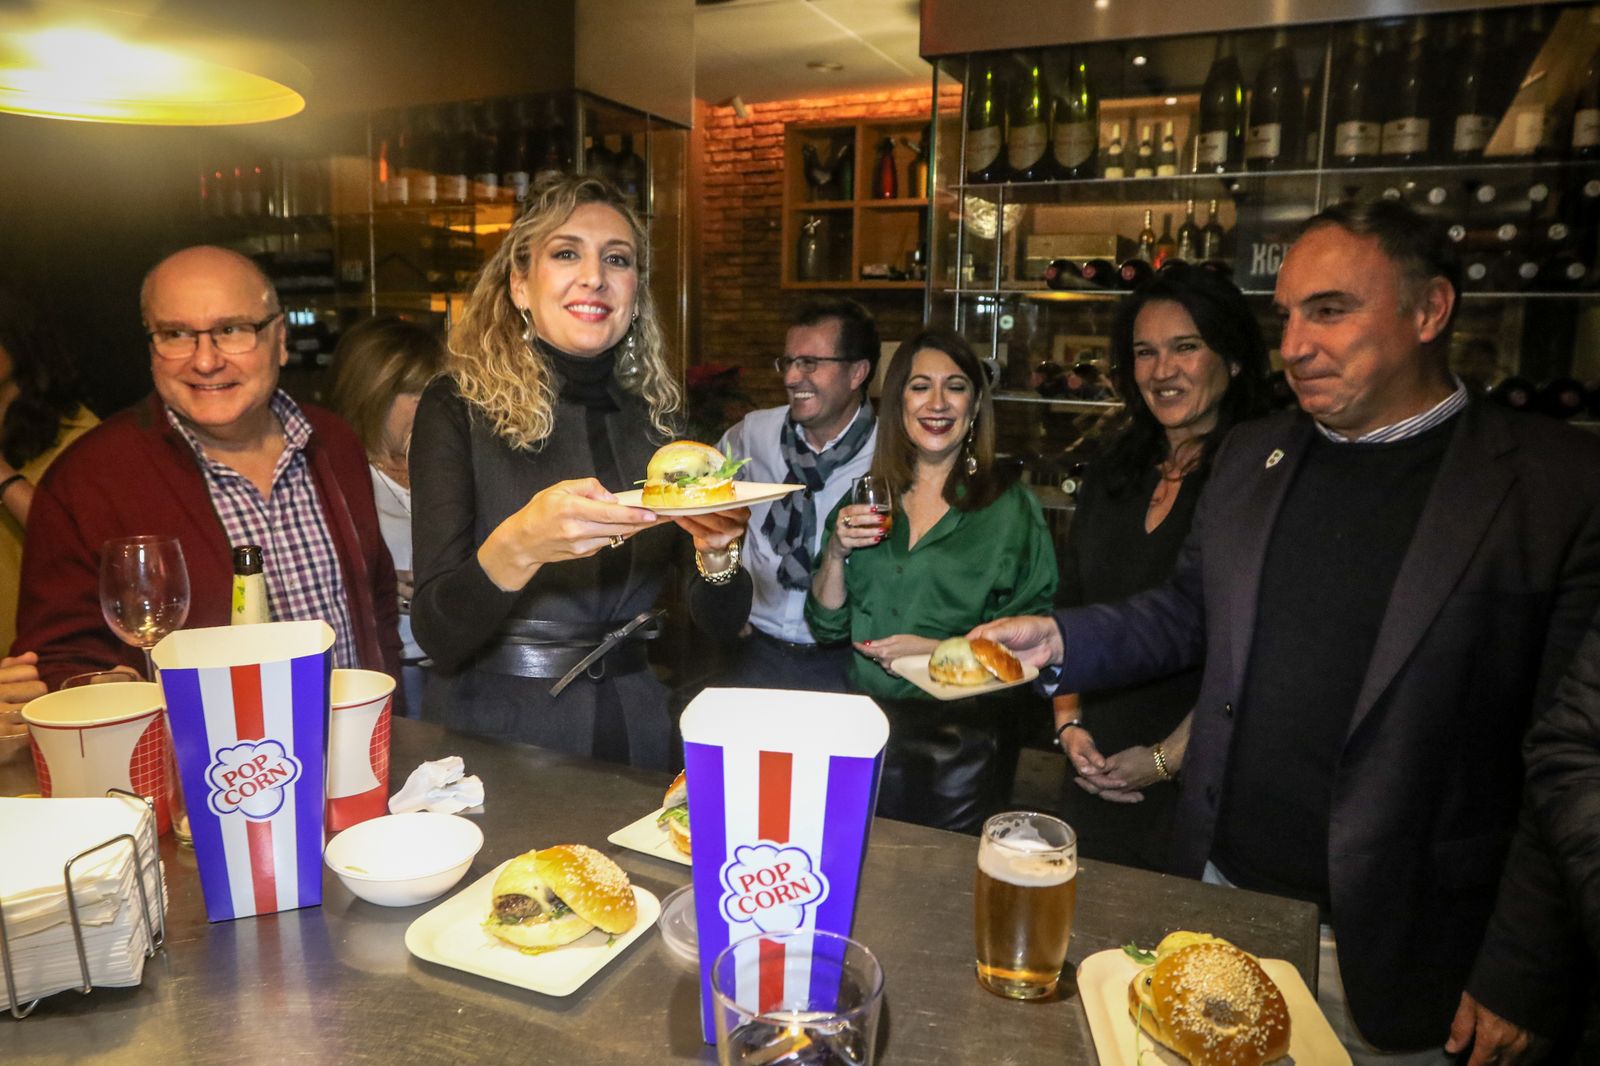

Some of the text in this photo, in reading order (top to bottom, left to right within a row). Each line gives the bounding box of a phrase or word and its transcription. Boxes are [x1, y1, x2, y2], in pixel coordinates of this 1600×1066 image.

[221, 754, 268, 788] POP
[224, 762, 288, 805] CORN
[738, 862, 791, 893] POP
[738, 877, 811, 914] CORN
